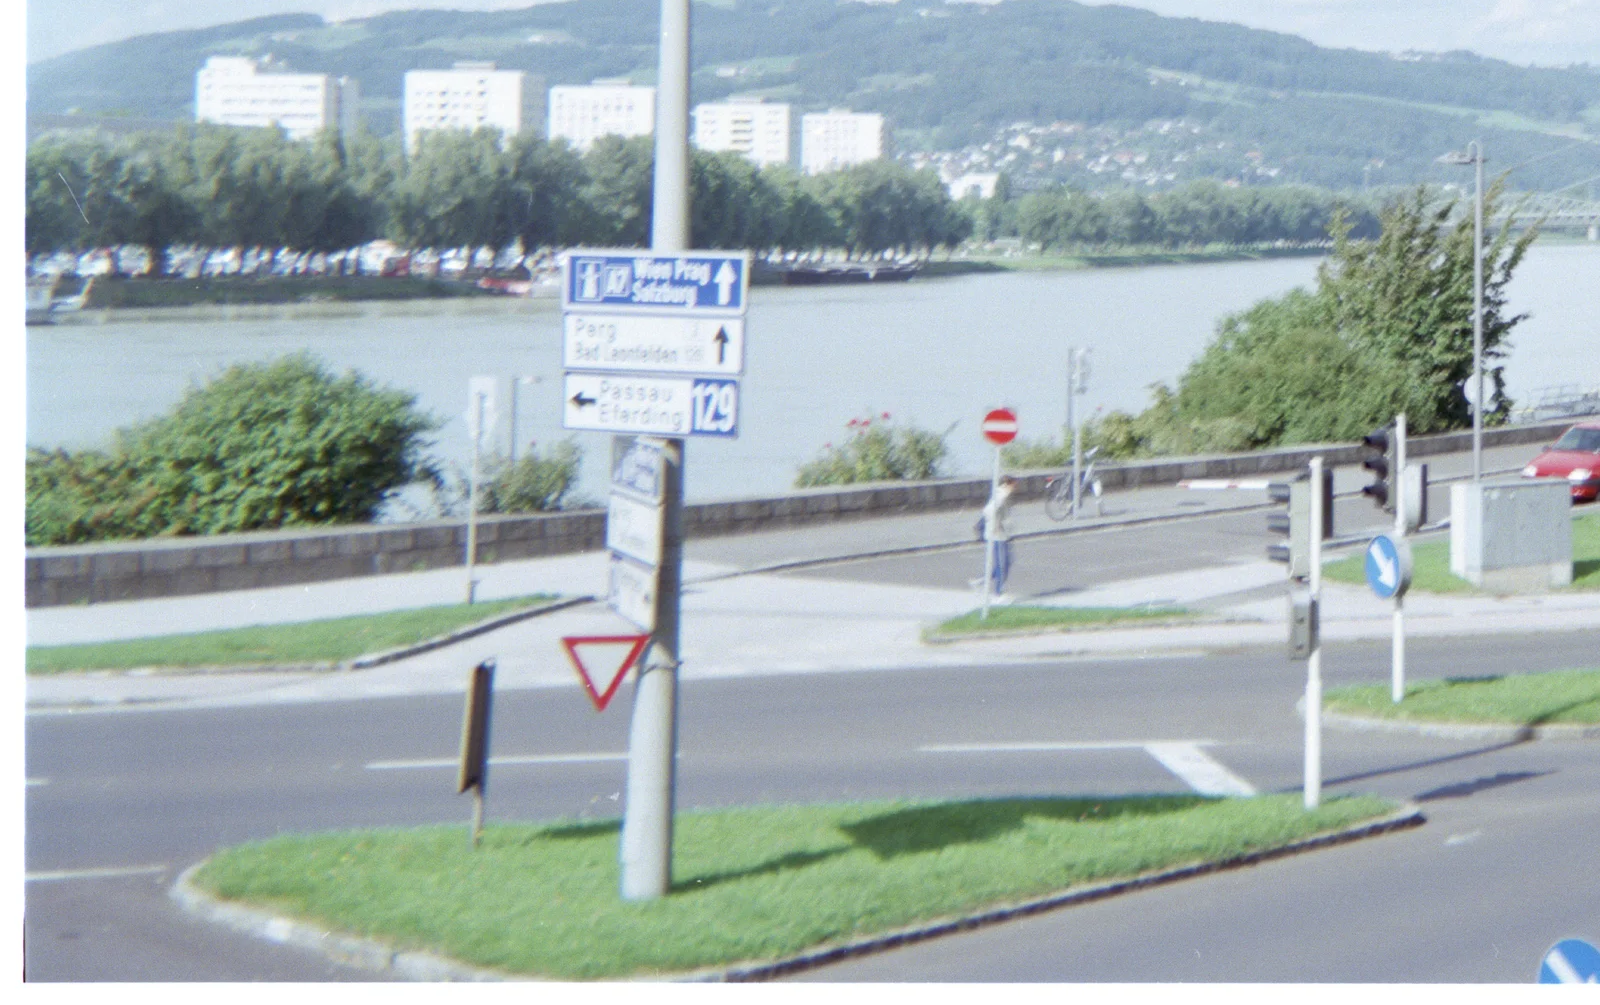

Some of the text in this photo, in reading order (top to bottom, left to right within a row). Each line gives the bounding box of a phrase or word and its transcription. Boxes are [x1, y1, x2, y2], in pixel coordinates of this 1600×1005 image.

[633, 258, 712, 286] Wien Prag
[632, 280, 698, 309] Salzburg
[574, 318, 618, 343] Perg
[599, 379, 674, 403] Passau
[599, 402, 685, 432] Eferding
[692, 383, 736, 432] 129
